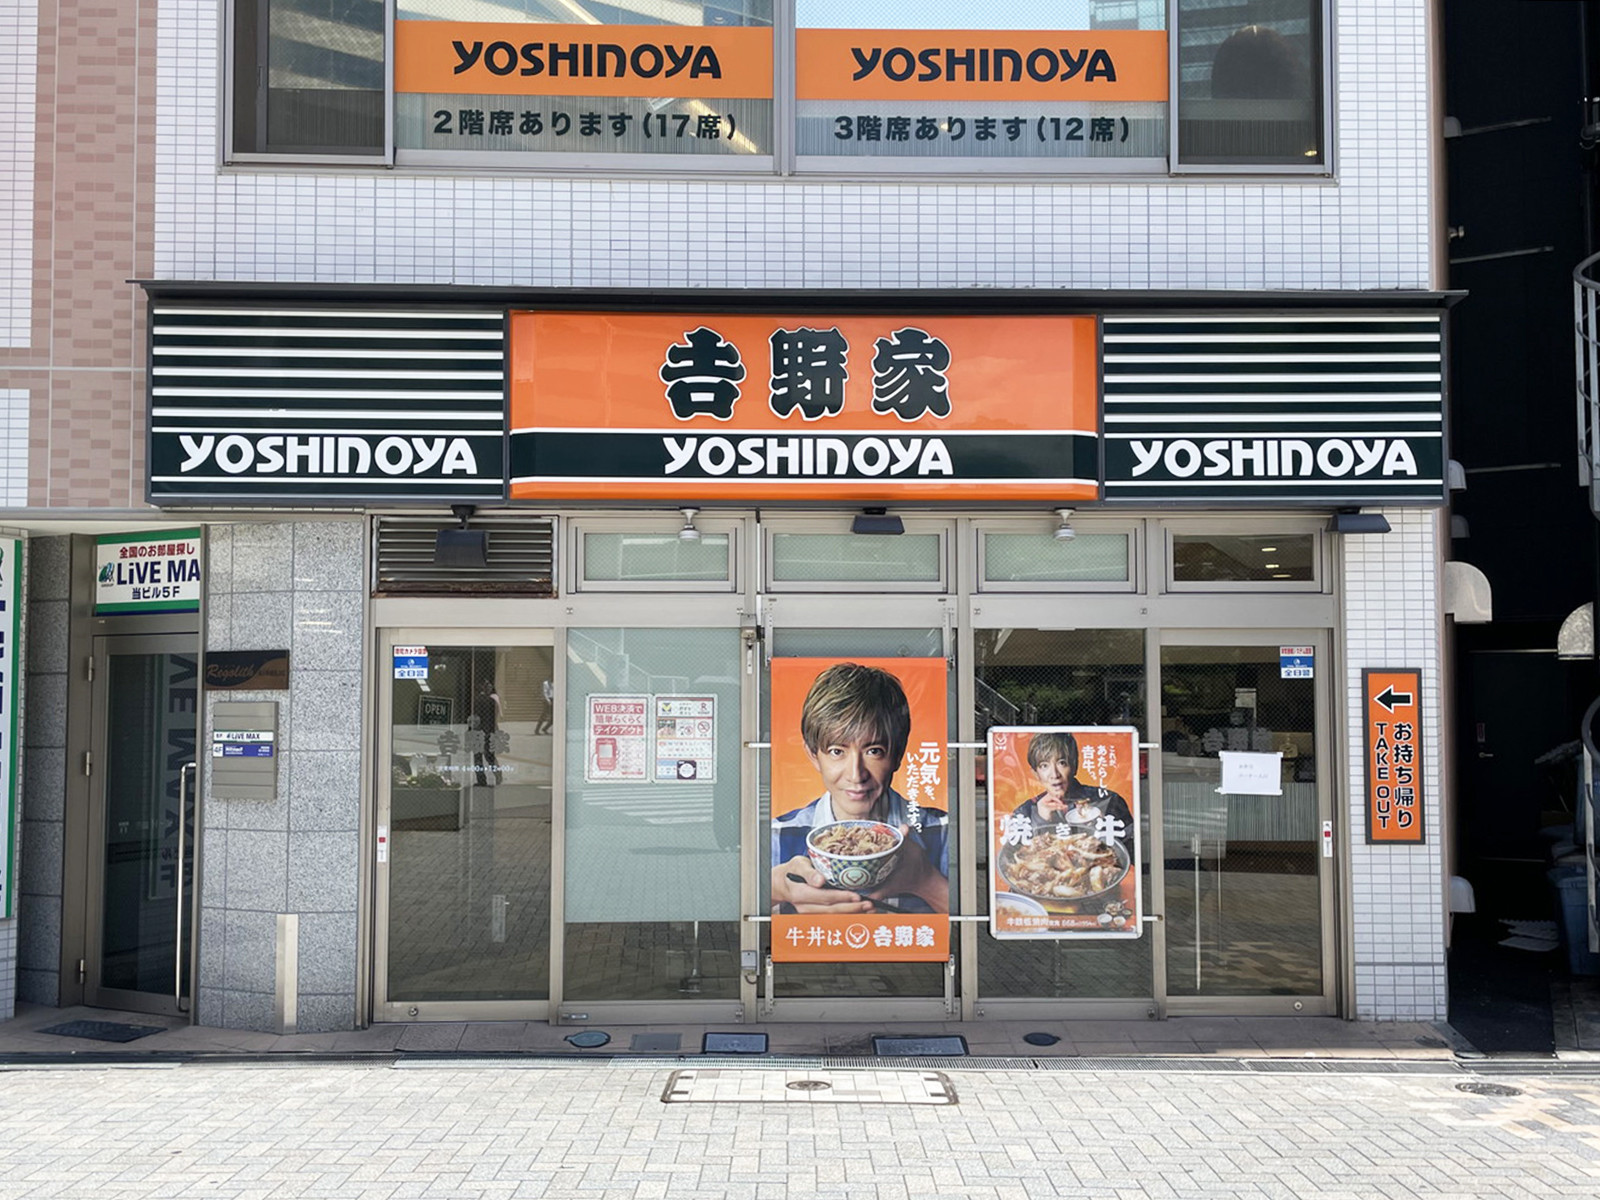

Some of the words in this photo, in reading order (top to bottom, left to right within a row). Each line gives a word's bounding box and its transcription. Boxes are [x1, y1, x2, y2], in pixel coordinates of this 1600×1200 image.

[452, 40, 722, 79] YOSHINOYA
[851, 47, 1117, 82] YOSHINOYA
[178, 434, 478, 475] YOSHINOYA
[662, 436, 954, 476] YOSHINOYA
[1129, 438, 1418, 478] YOSHINOYA
[119, 543, 195, 559] 全国のお部屋探し
[595, 726, 643, 735] テイクアウト
[1097, 744, 1109, 798] あたらしい
[1375, 722, 1390, 781] TAKE
[1393, 722, 1415, 829] お持ち帰り
[1376, 785, 1391, 829] OUT
[785, 925, 843, 947] 牛丼は
